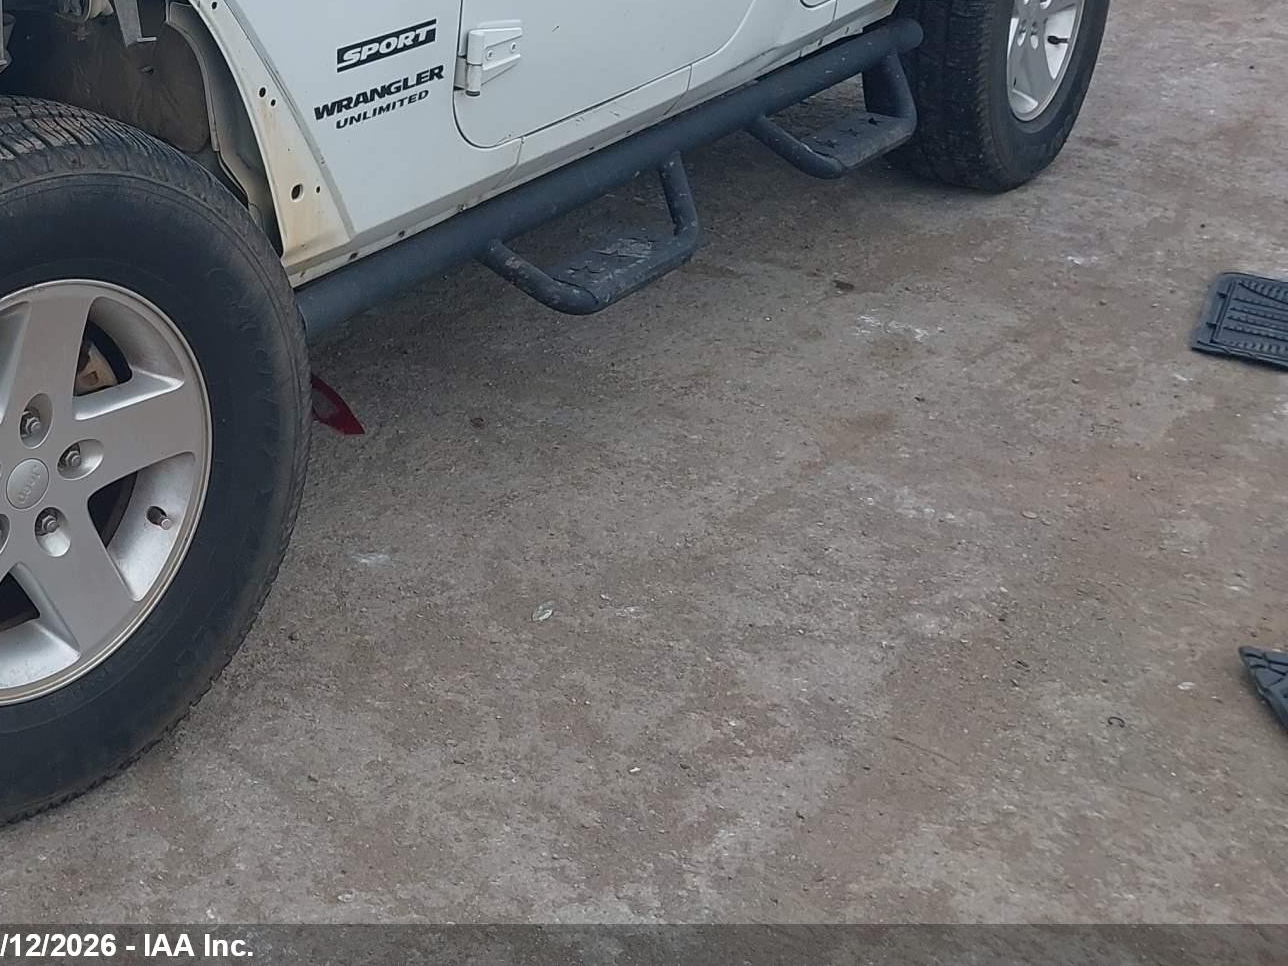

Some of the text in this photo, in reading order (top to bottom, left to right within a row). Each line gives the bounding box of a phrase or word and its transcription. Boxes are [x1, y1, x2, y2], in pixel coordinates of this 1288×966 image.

[337, 22, 437, 68] SPORT
[313, 64, 445, 121] WRANGLER
[335, 89, 429, 130] UNLIMITED
